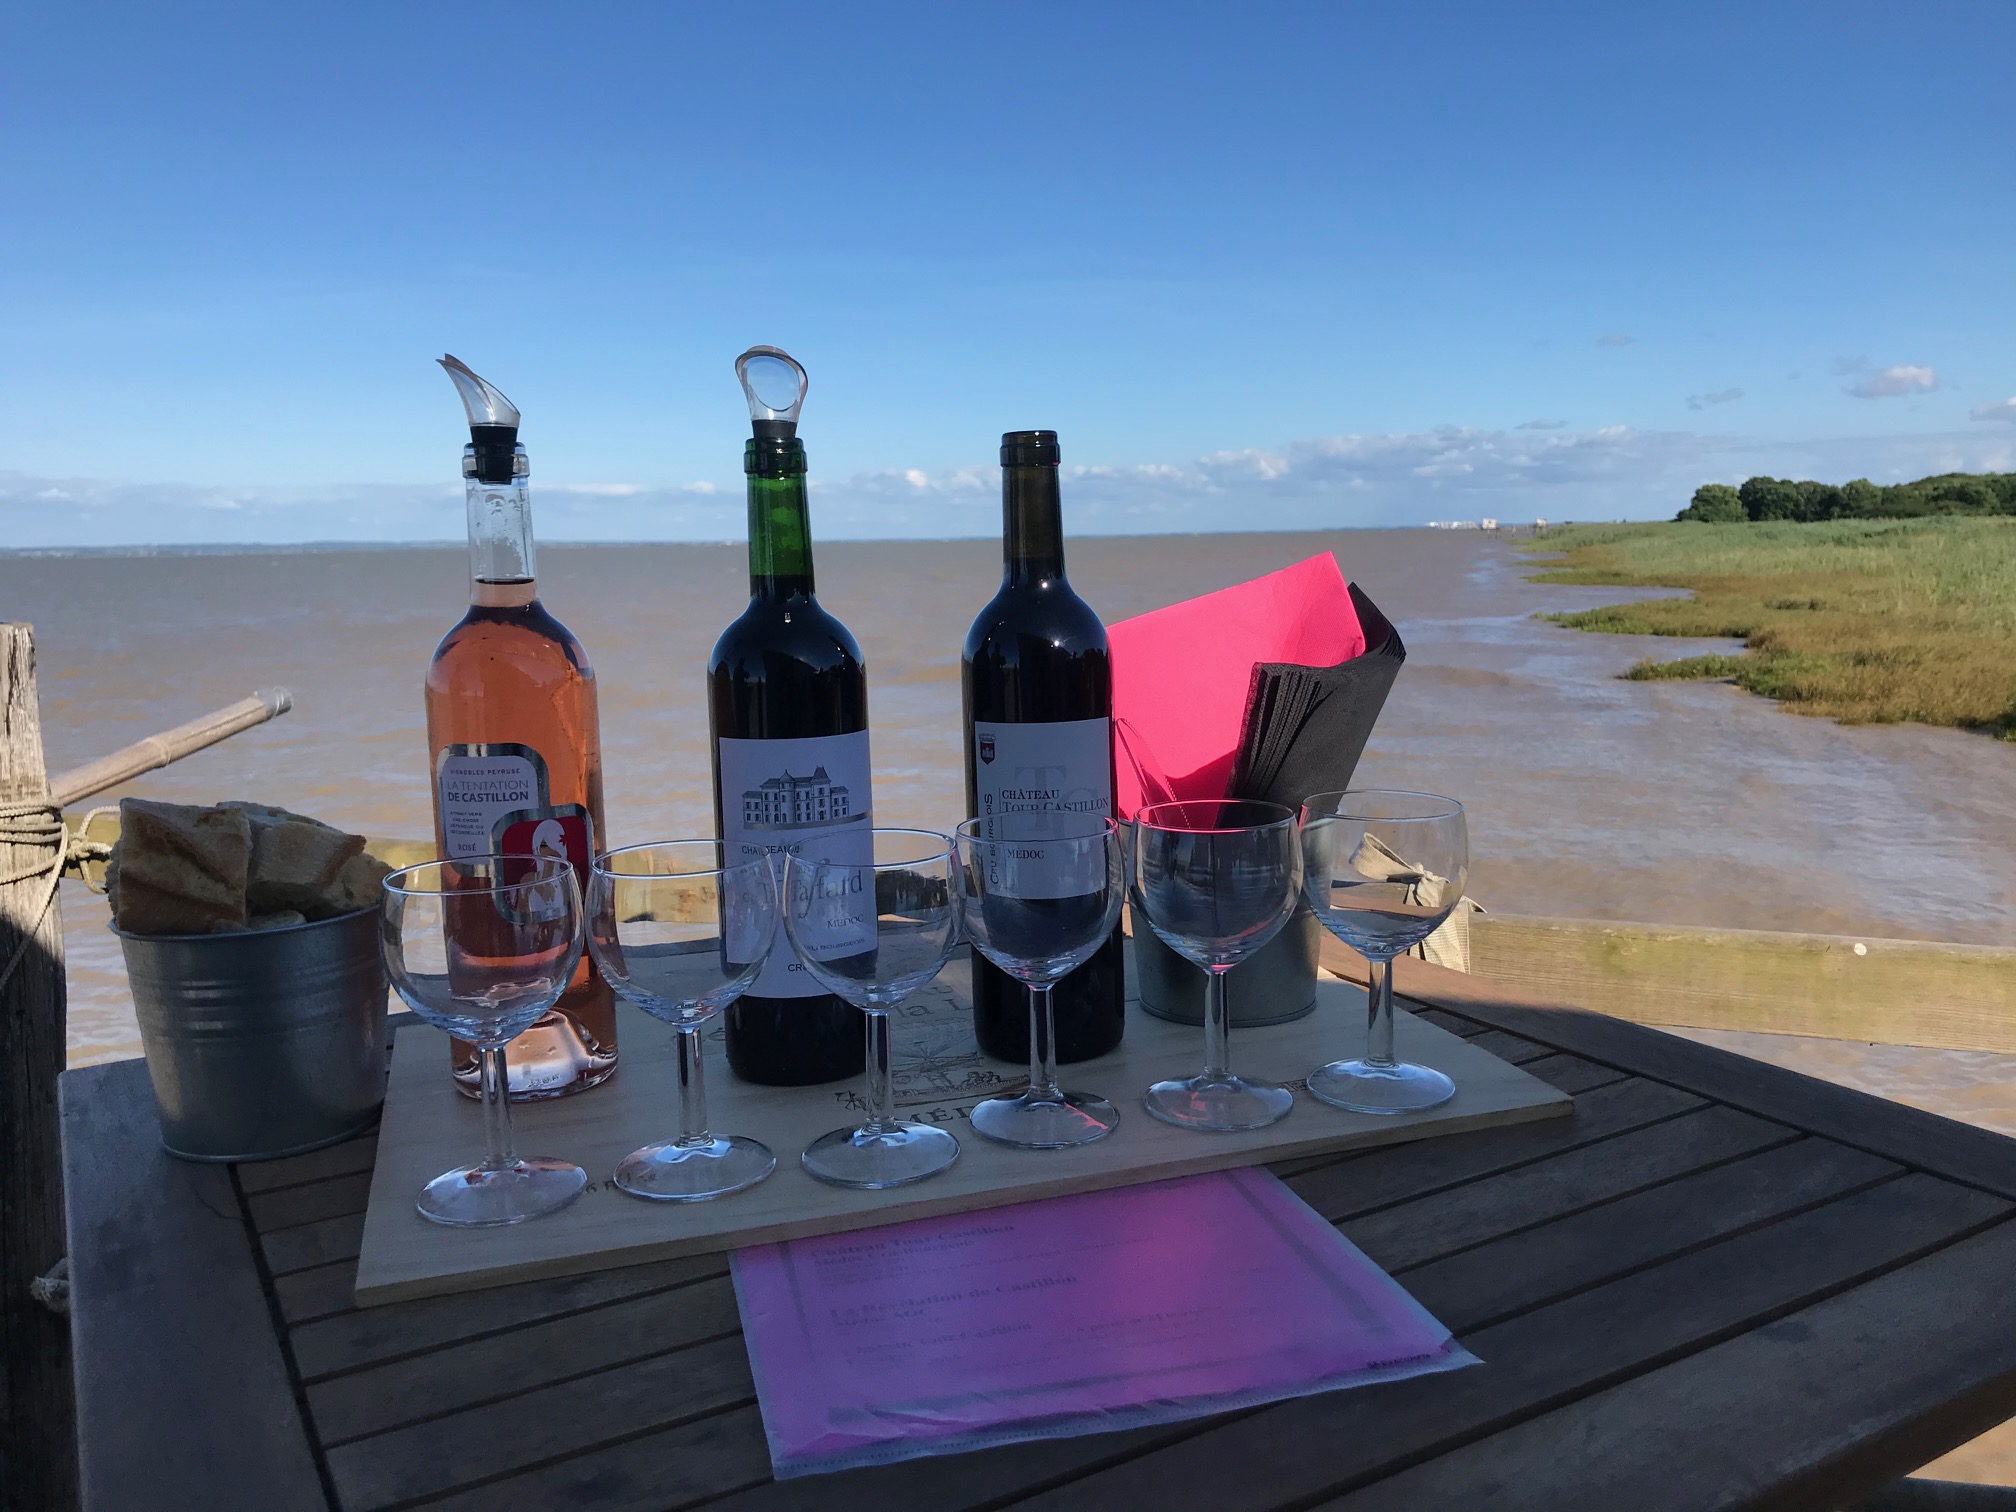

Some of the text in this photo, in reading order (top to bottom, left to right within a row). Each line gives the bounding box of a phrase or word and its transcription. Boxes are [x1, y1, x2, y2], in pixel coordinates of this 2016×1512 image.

[460, 779, 529, 791] TENTATION
[448, 791, 529, 803] DE CASTILLON
[1002, 788, 1060, 800] CHÂTEAU
